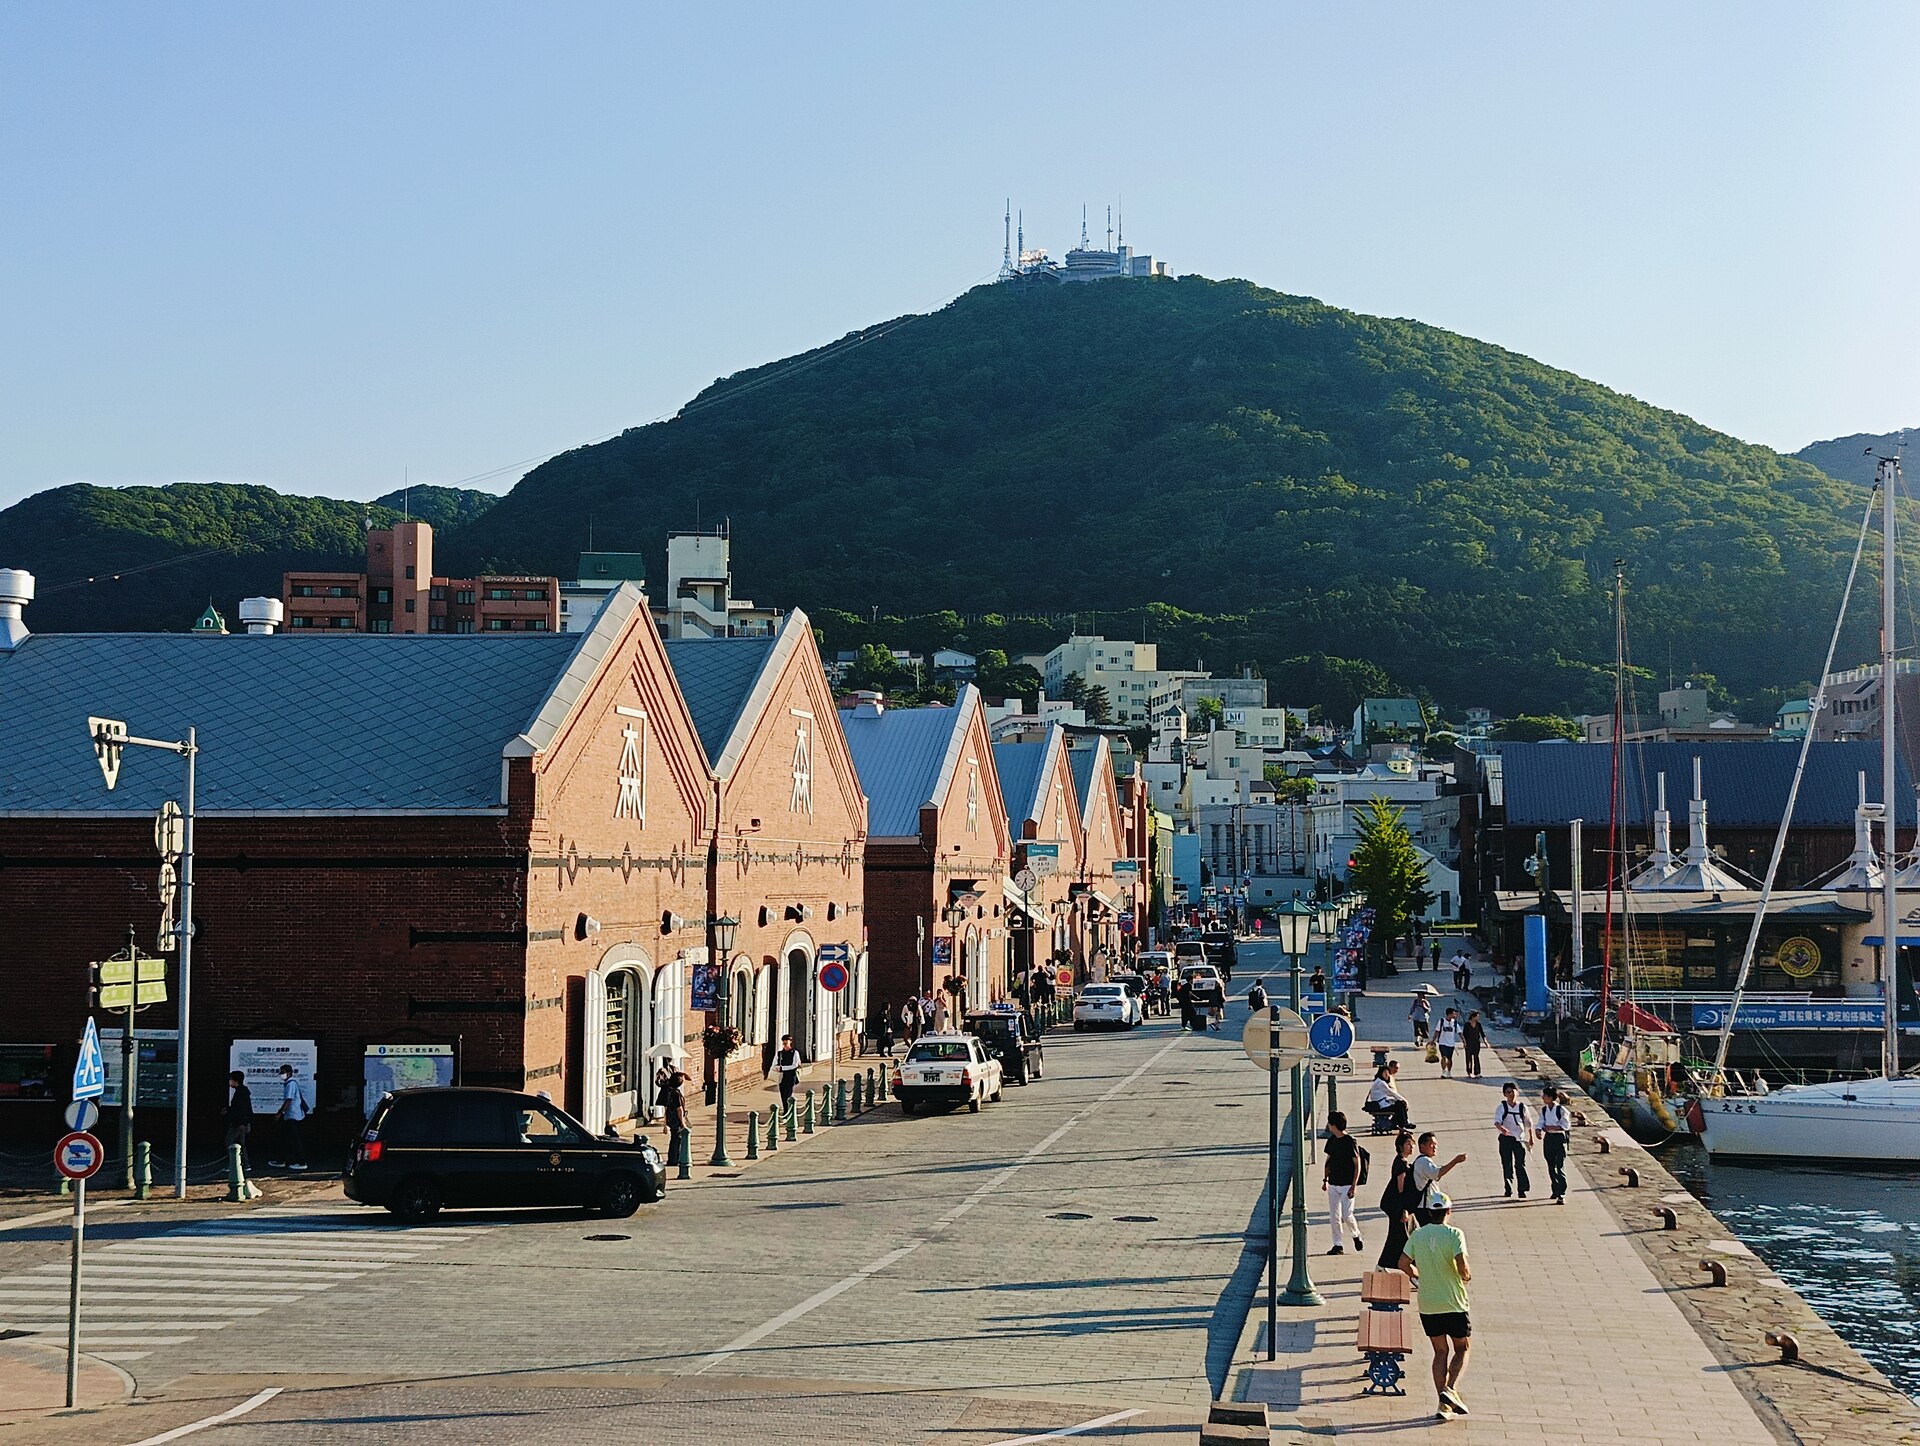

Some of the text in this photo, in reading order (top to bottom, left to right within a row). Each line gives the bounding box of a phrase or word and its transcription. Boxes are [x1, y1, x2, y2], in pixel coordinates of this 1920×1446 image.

[1313, 1062, 1352, 1074] ここから
[1722, 1103, 1757, 1114] えとも
